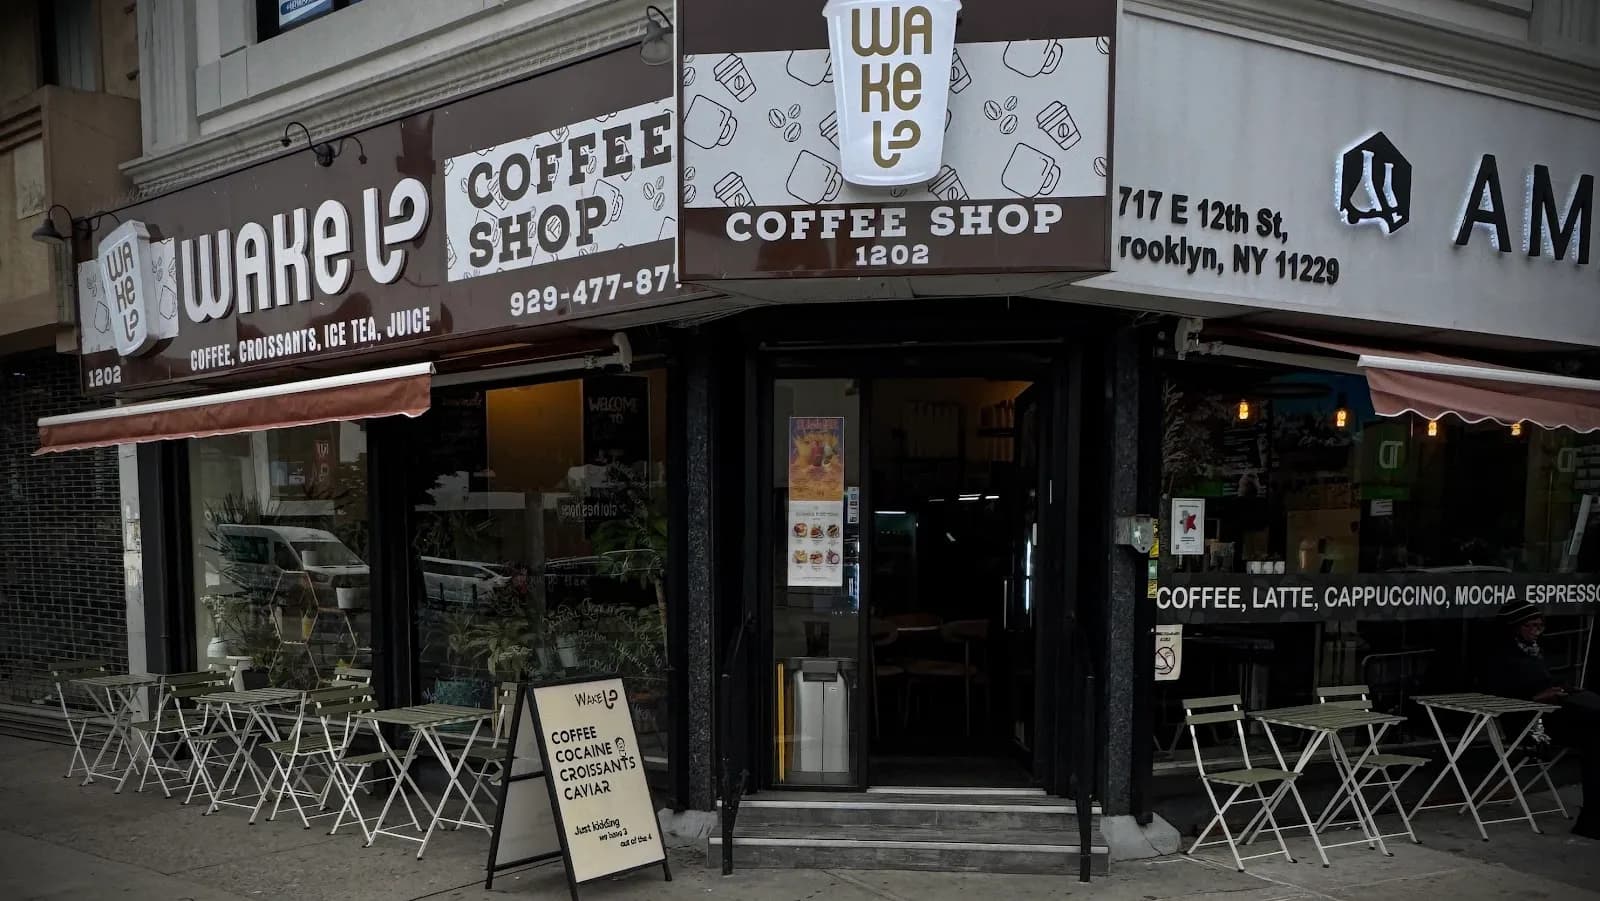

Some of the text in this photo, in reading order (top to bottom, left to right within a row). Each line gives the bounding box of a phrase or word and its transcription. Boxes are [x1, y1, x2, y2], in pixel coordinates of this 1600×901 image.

[851, 6, 933, 58] WA
[467, 112, 673, 209] COFFEE
[469, 195, 608, 269] SHOP
[725, 202, 1063, 242] COFFEE SHOP
[1171, 194, 1188, 225] E
[1198, 198, 1249, 234] 12th
[1256, 208, 1288, 244] St,
[855, 243, 930, 267] 1202
[1117, 234, 1340, 285] rooklyn, NY 11229
[509, 263, 682, 317] 929-477-87
[190, 306, 431, 372] COFFEE, CROISSANTS, ICE TEA, JUICE
[88, 364, 122, 387] 1202
[1156, 586, 1247, 613] COFFEE,
[1252, 586, 1319, 612] LATTE,
[1324, 585, 1450, 609] CAPPUCCINO,
[551, 726, 597, 745] COFFEE
[555, 742, 613, 763] COCAINE
[559, 756, 636, 783] CROISSANTS
[564, 780, 611, 801] CAVIAR
[574, 818, 620, 836] Just kidding
